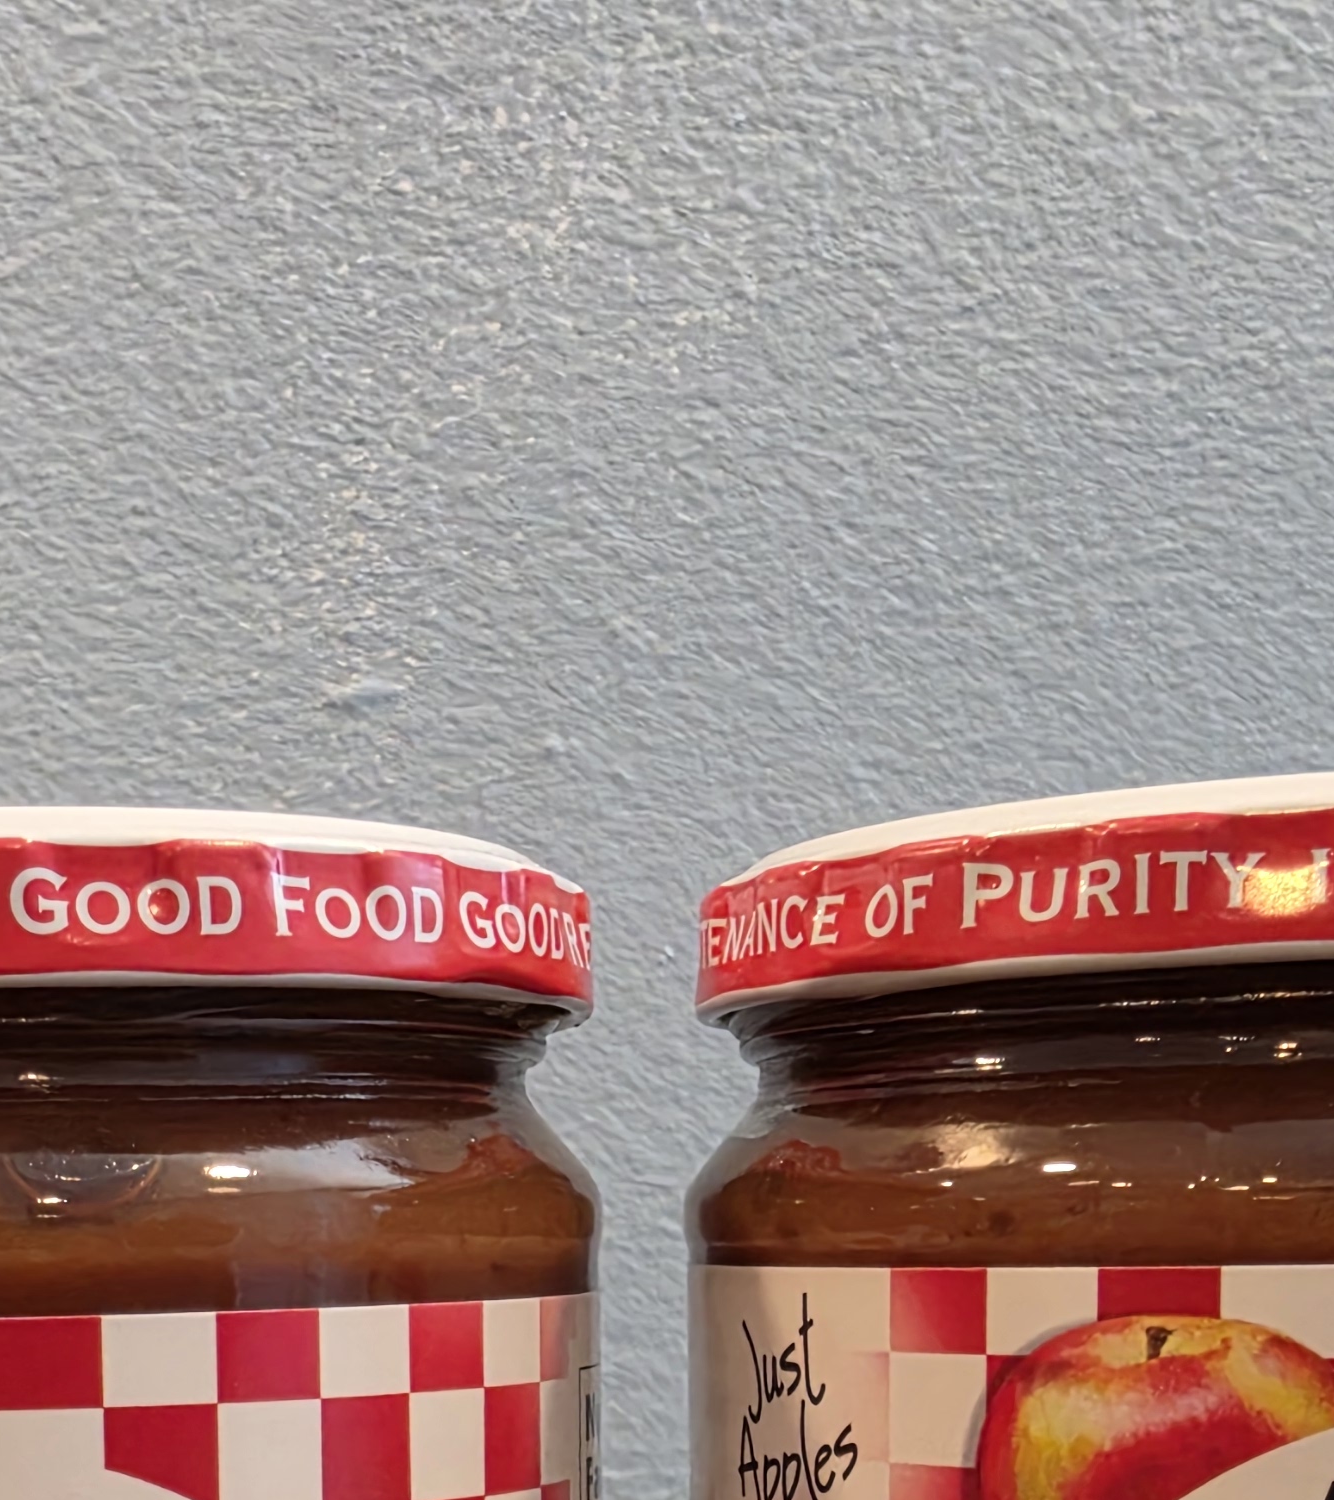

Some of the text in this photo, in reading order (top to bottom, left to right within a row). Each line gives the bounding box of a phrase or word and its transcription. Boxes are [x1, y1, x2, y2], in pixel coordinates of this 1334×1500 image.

[10, 866, 243, 936] GOOD
[271, 872, 444, 943] FOOD
[864, 873, 933, 939] OF
[960, 850, 1264, 930] PURITY
[742, 1292, 826, 1424] Just
